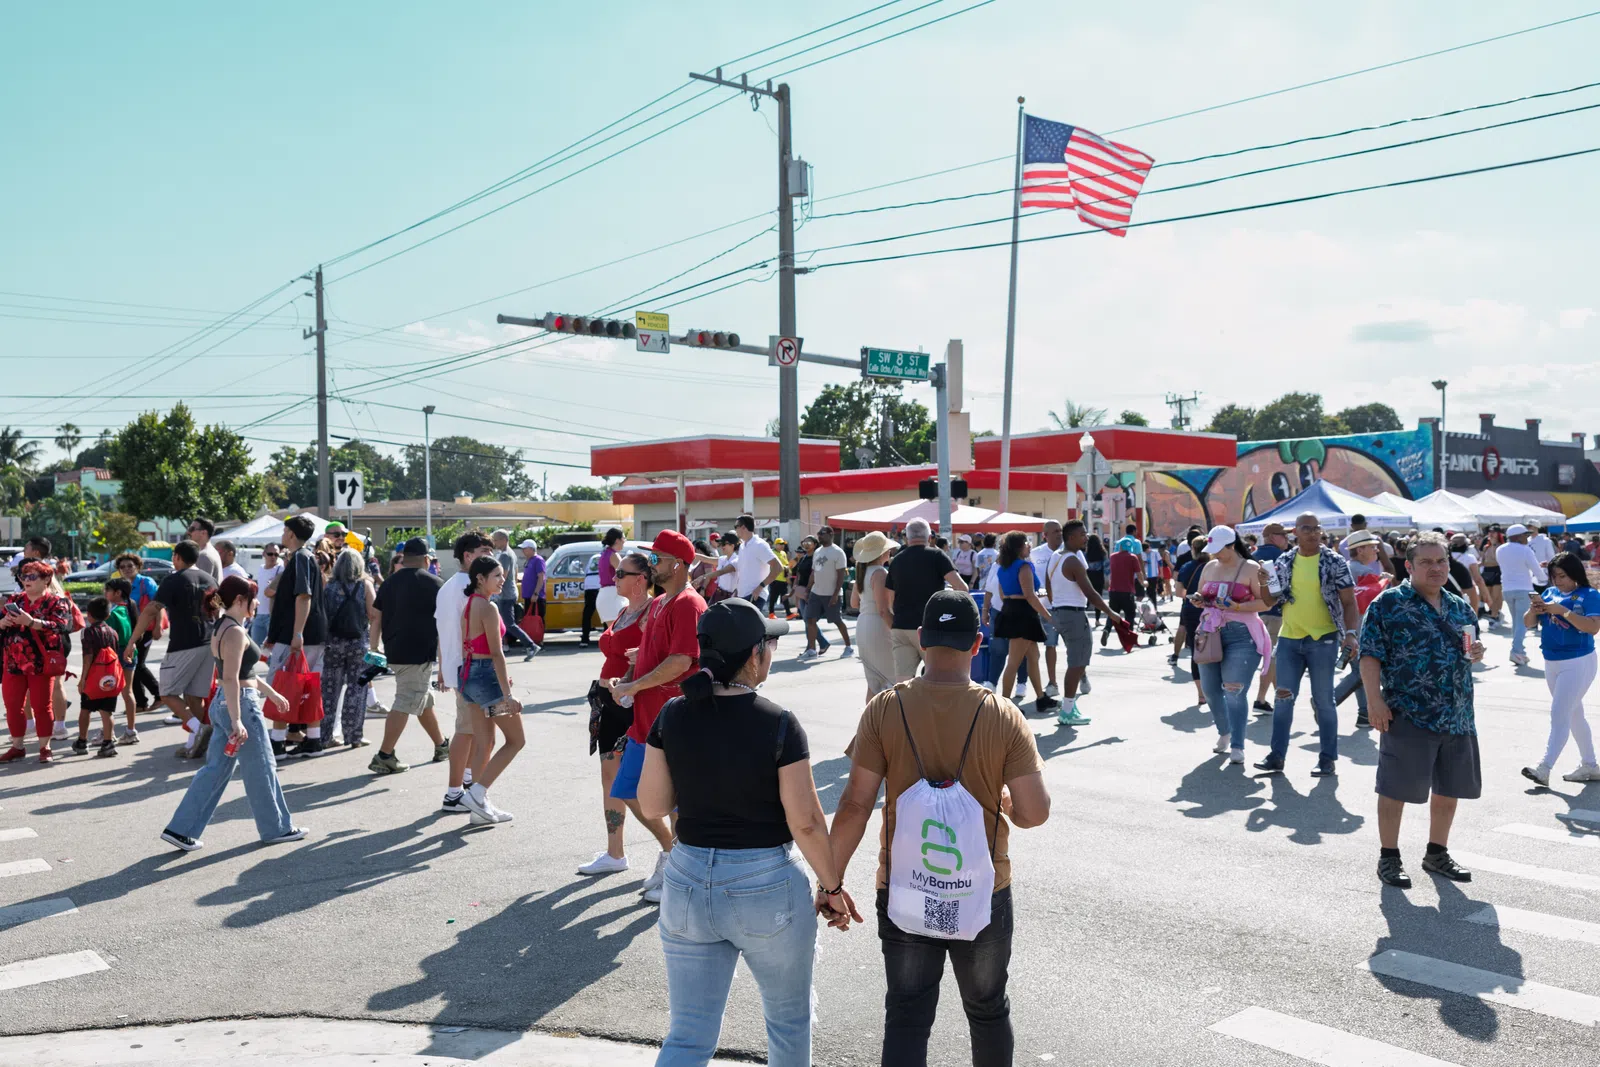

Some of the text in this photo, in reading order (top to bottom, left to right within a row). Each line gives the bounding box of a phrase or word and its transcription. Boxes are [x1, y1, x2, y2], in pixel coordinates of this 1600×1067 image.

[878, 352, 920, 366] SW 8 ST
[1439, 453, 1484, 472] FANCY
[1500, 457, 1539, 476] PUFFS
[554, 581, 584, 597] FRESC
[912, 869, 972, 890] MyBambu
[909, 881, 917, 889] Tu
[917, 884, 939, 898] Cuenta
